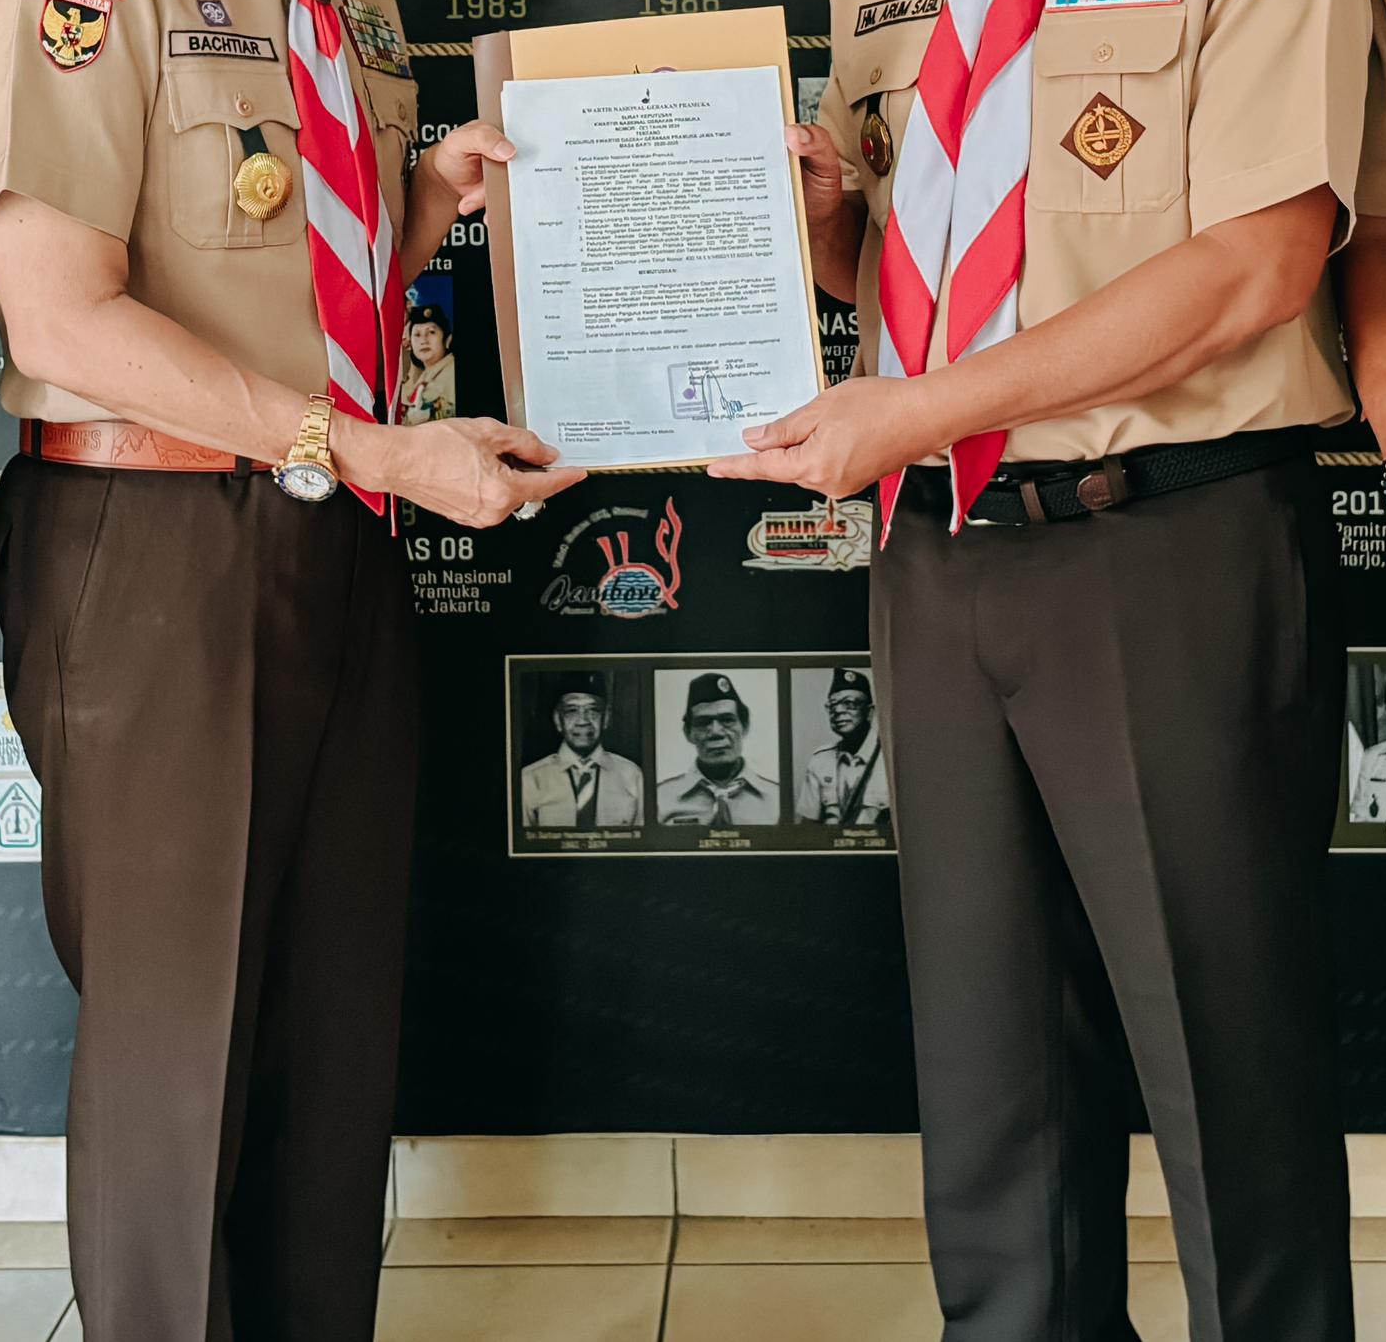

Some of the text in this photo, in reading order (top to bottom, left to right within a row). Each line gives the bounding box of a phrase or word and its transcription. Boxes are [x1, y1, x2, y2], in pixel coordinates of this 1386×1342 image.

[878, 0, 912, 23] ARUM
[188, 35, 262, 56] BACHTIAR
[440, 536, 474, 561] 08
[443, 569, 512, 584] Nasional
[429, 598, 491, 614] Jakarta
